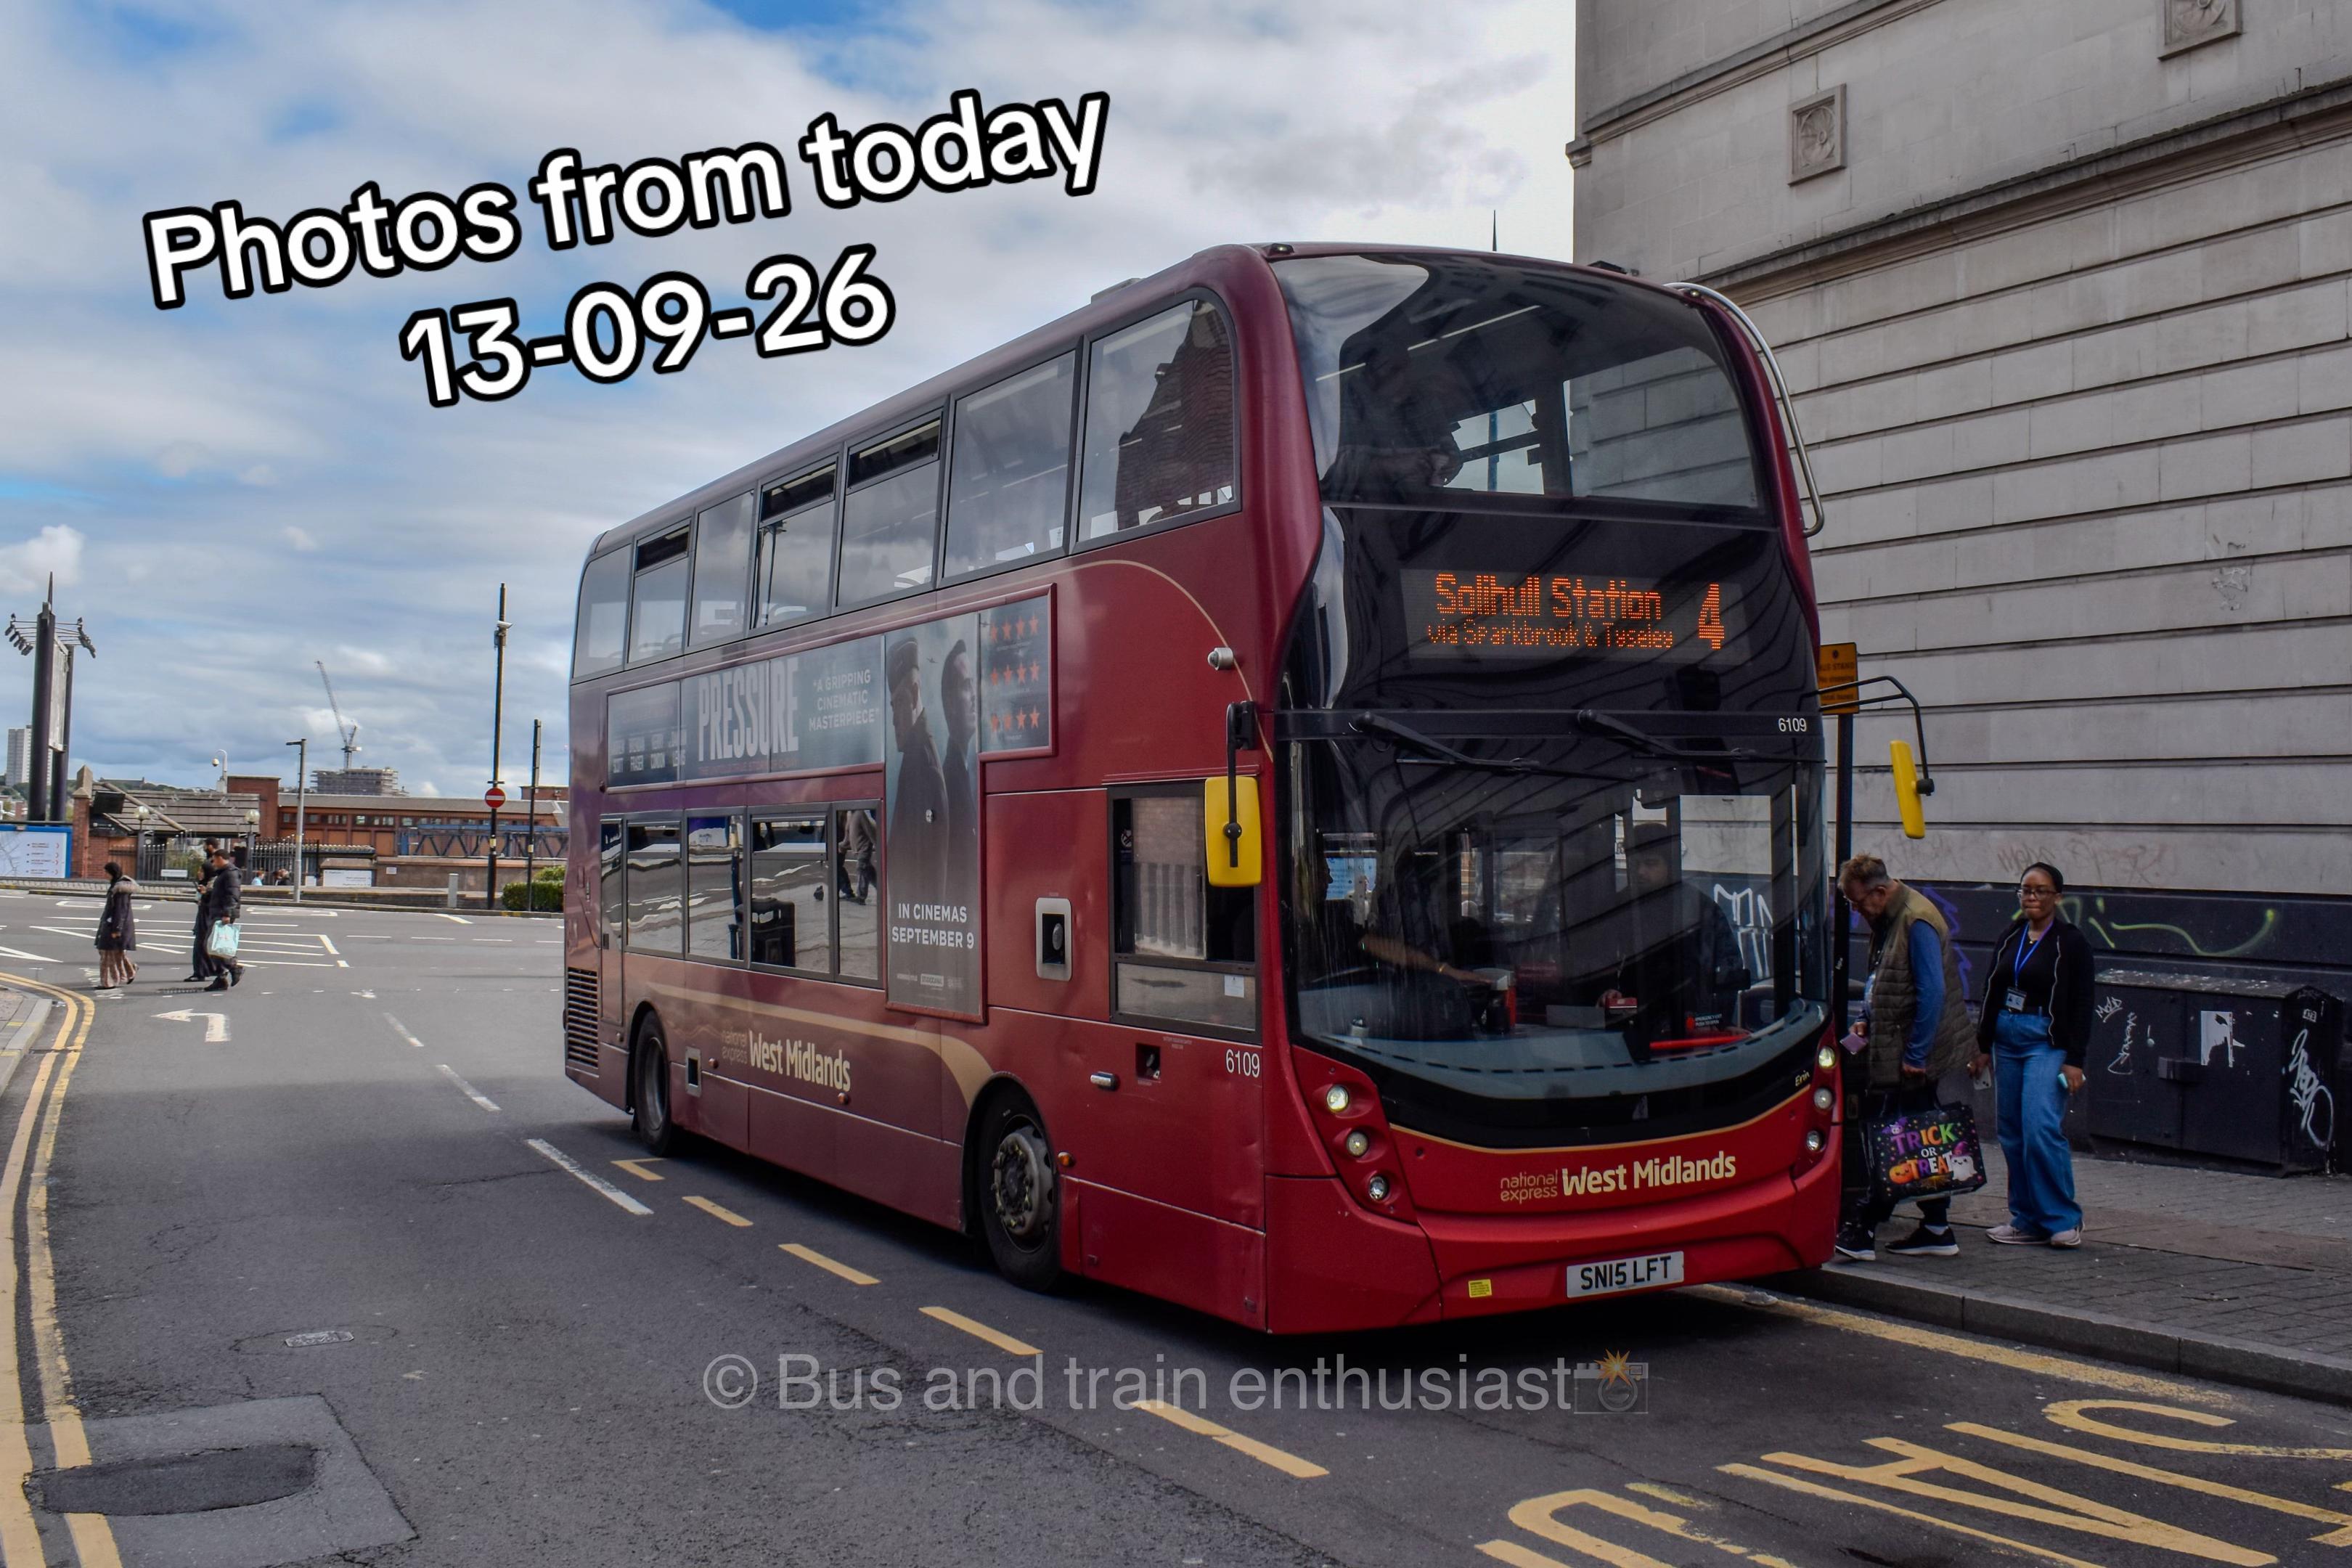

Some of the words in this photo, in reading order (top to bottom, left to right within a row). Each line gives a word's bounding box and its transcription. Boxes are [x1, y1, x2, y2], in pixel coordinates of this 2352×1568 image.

[1436, 573, 1540, 616] Solihull
[1551, 576, 1662, 620] Station
[1698, 582, 1725, 650] 4
[1428, 618, 1458, 645] via
[1463, 618, 1580, 647] Sparkbrook
[1584, 621, 1598, 647] &
[825, 669, 871, 691] GRIPPING
[698, 658, 799, 761] PRESSURE
[817, 690, 868, 711] CINEMATIC
[1778, 717, 1808, 732] 6109
[898, 902, 910, 919] IN
[913, 903, 968, 923] CINEMAS
[891, 926, 963, 948] SEPTEMBER
[966, 932, 974, 950] 9
[748, 1028, 784, 1075] West
[785, 1038, 851, 1092] Midlands
[1225, 1048, 1260, 1078] 6109
[1890, 1122, 1959, 1156] TRICK
[1920, 1146, 1937, 1158] OR
[1500, 1169, 1559, 1189] national
[1561, 1164, 1628, 1196] West
[1633, 1150, 1736, 1189] Midlands
[1906, 1151, 1953, 1180] TREAT
[1500, 1185, 1559, 1204] express
[1580, 1262, 1627, 1291] SN15
[1633, 1254, 1672, 1283] LFT
